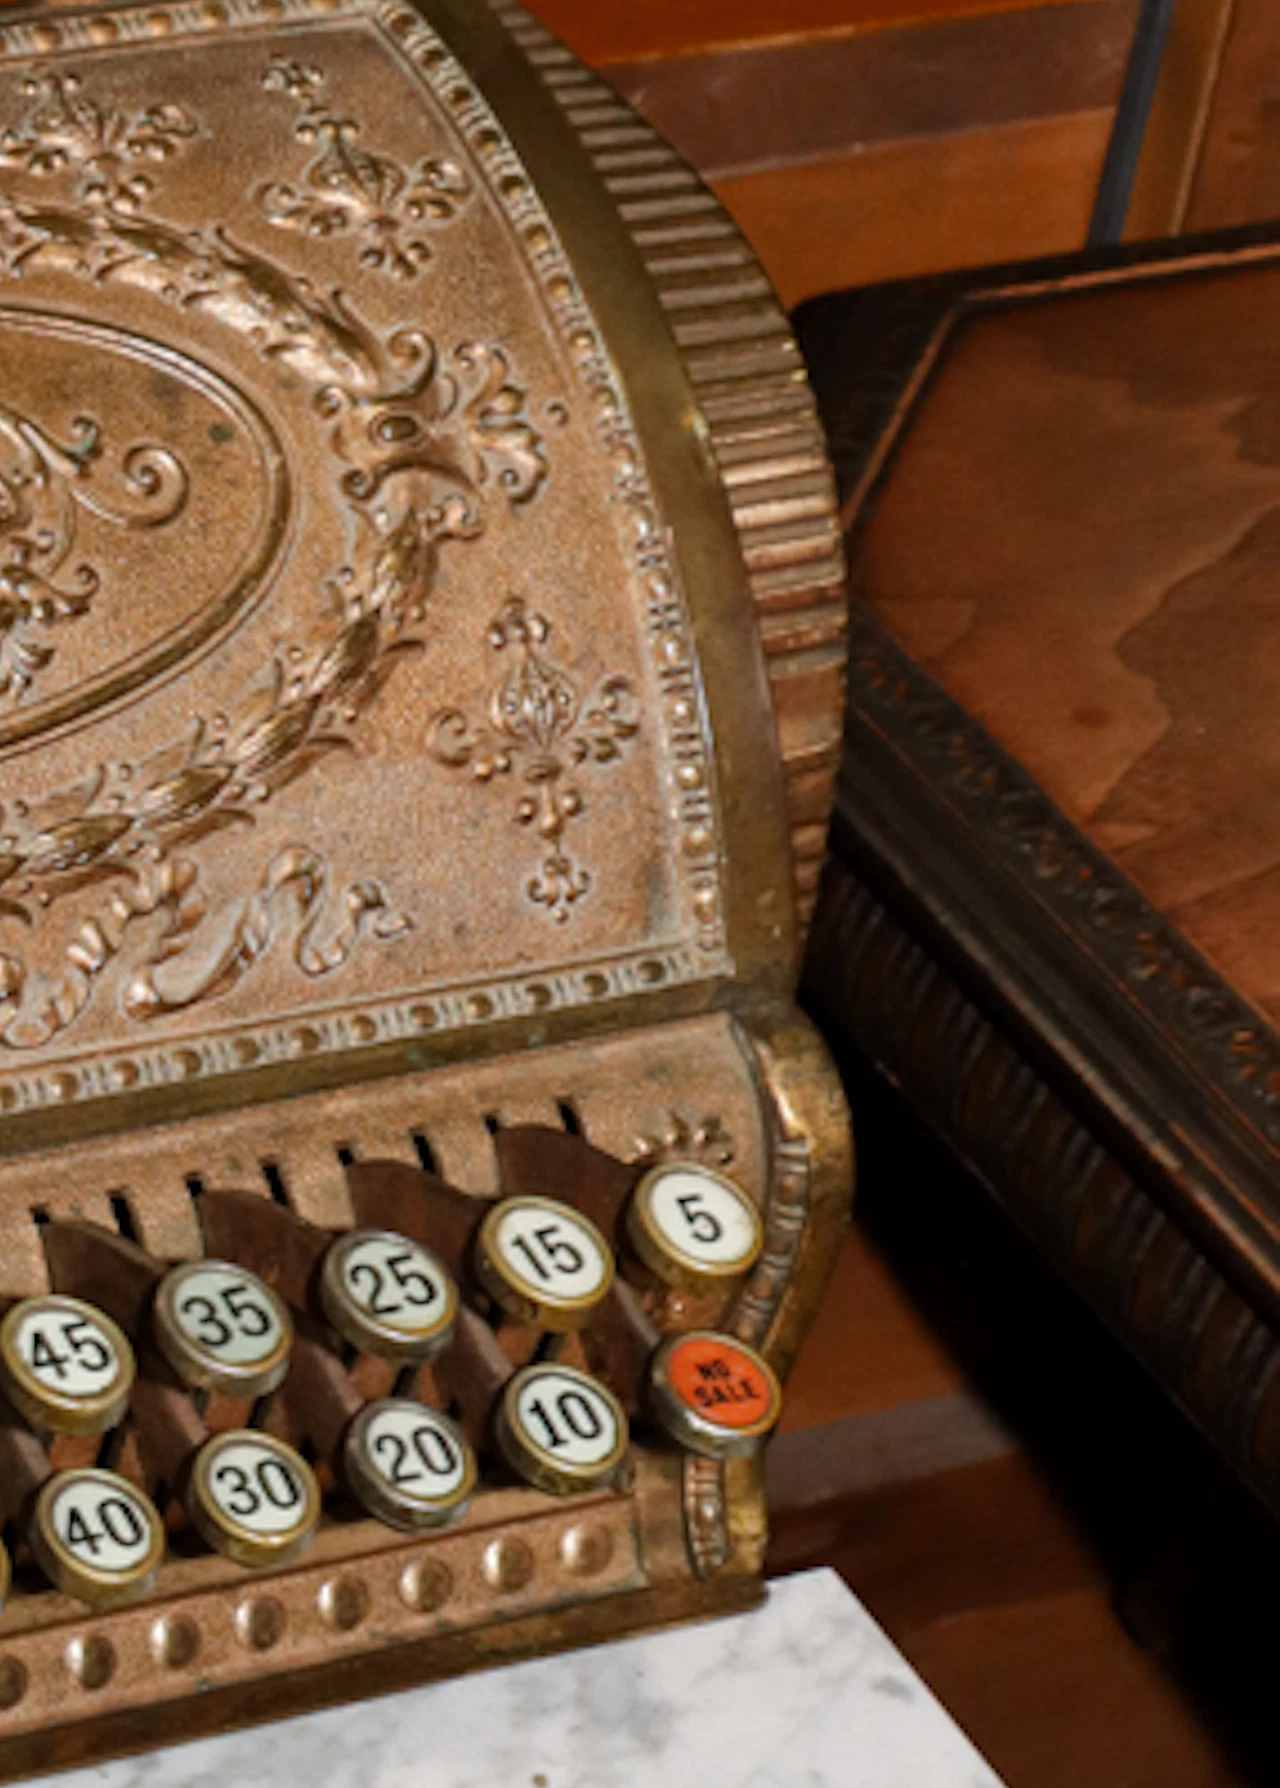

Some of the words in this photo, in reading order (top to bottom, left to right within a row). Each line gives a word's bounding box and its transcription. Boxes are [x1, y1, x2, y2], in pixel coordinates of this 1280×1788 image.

[678, 1190, 722, 1244] 5
[512, 1225, 585, 1282] 15
[350, 1254, 437, 1316] 25
[181, 1285, 271, 1348] 35
[32, 1321, 110, 1378] 45
[695, 1359, 731, 1381] NO
[529, 1390, 603, 1449] 10
[694, 1378, 762, 1408] SALE
[373, 1424, 459, 1485] 20
[215, 1458, 302, 1516] 30
[66, 1497, 144, 1556] 40
